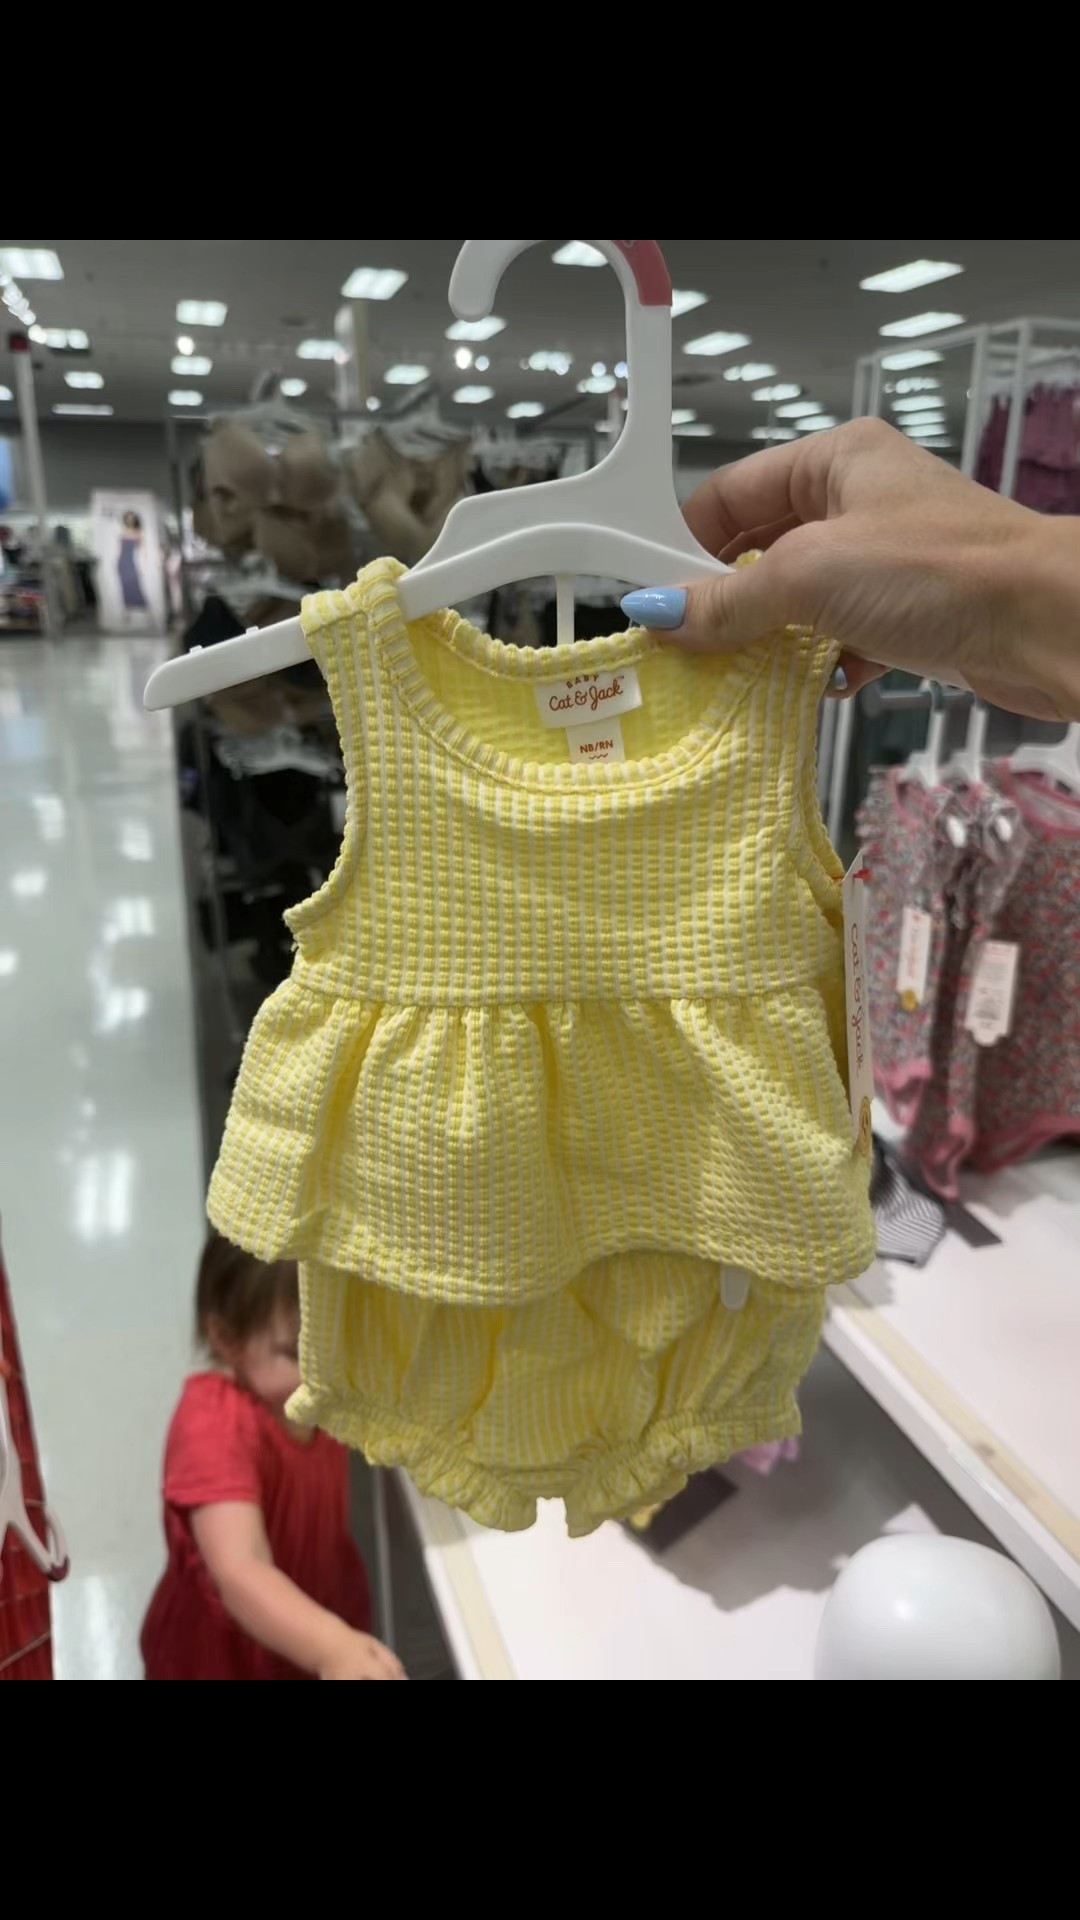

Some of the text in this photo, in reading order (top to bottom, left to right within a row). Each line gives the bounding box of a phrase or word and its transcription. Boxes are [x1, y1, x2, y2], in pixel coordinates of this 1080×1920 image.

[566, 674, 599, 689] BABY
[549, 678, 624, 711] Cat & Jack
[580, 740, 614, 754] NB/RN
